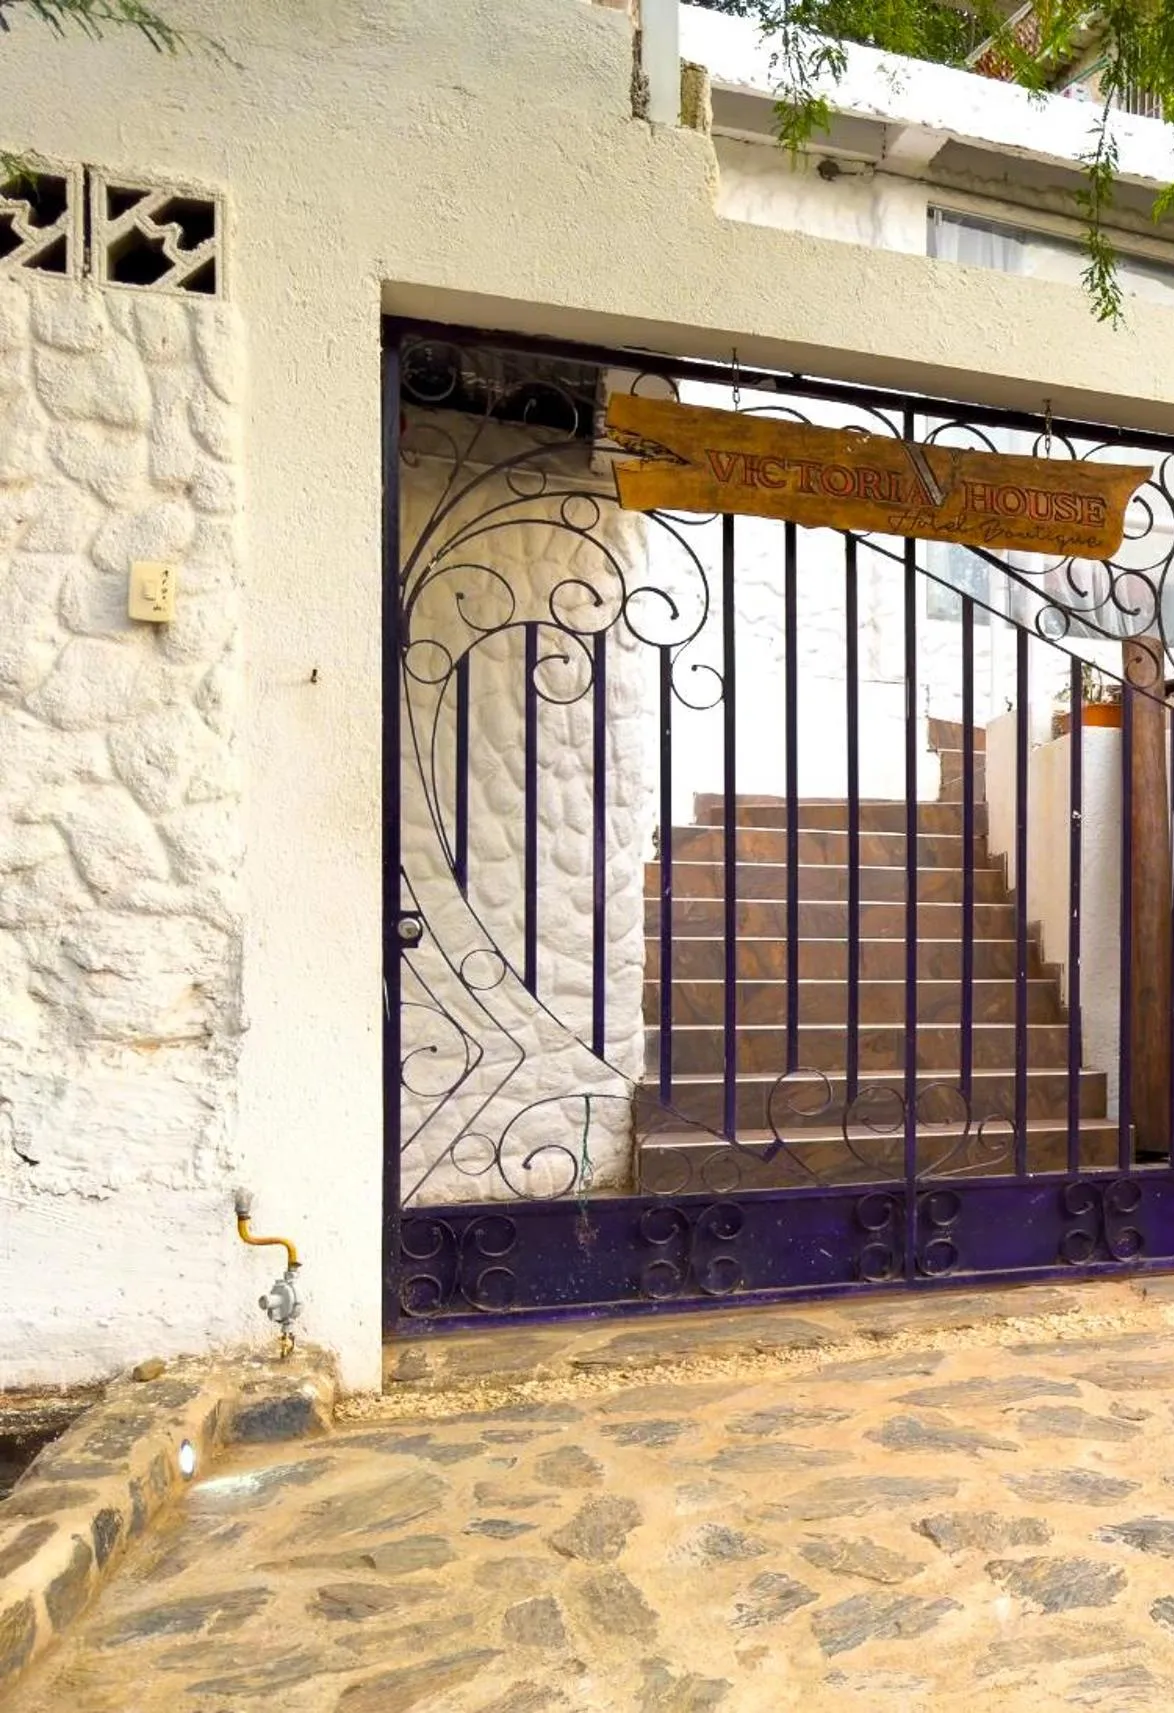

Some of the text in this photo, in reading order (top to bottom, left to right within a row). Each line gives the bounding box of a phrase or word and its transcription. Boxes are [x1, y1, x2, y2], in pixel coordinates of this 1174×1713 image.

[704, 448, 935, 507] VICTORIA
[961, 478, 1107, 529] HOUSE
[978, 519, 1104, 551] Boutique
